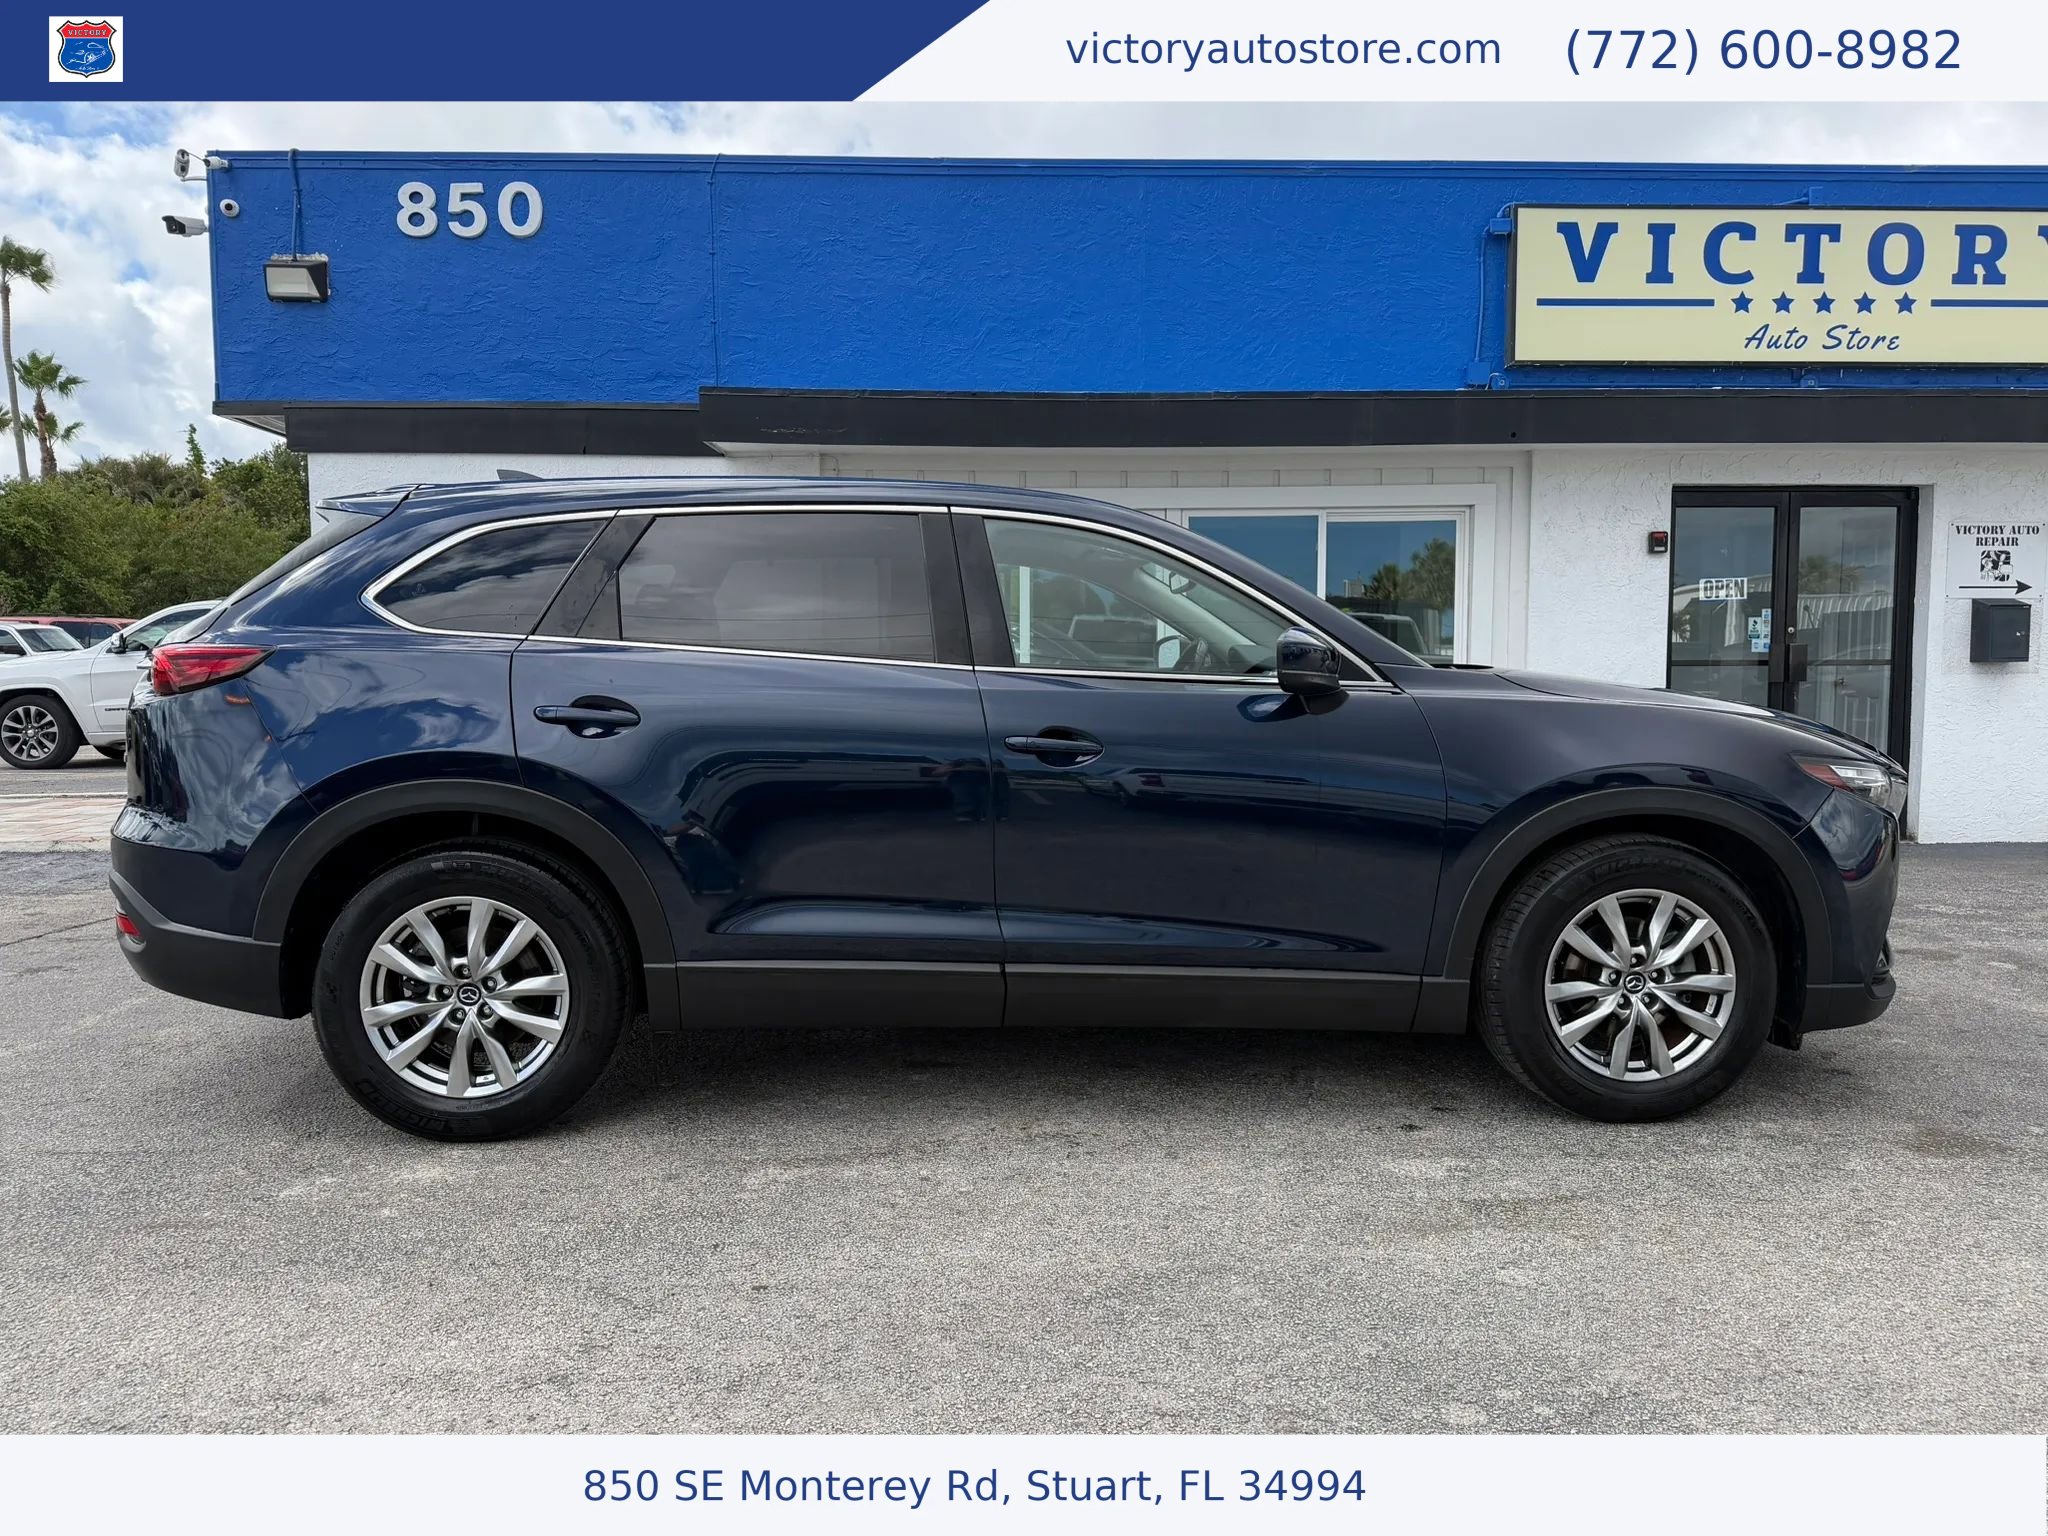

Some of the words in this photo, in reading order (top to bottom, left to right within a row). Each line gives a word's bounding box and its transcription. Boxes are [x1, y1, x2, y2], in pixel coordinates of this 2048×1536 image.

[396, 181, 543, 237] 850
[1557, 221, 2048, 285] VICTOR
[1745, 323, 1809, 351] Auto
[1821, 323, 1901, 351] Store
[1956, 525, 2006, 535] VICTORY
[2009, 525, 2040, 535] AUTO
[1976, 537, 2019, 546] REPAIR
[1704, 579, 1744, 598] OPEN
